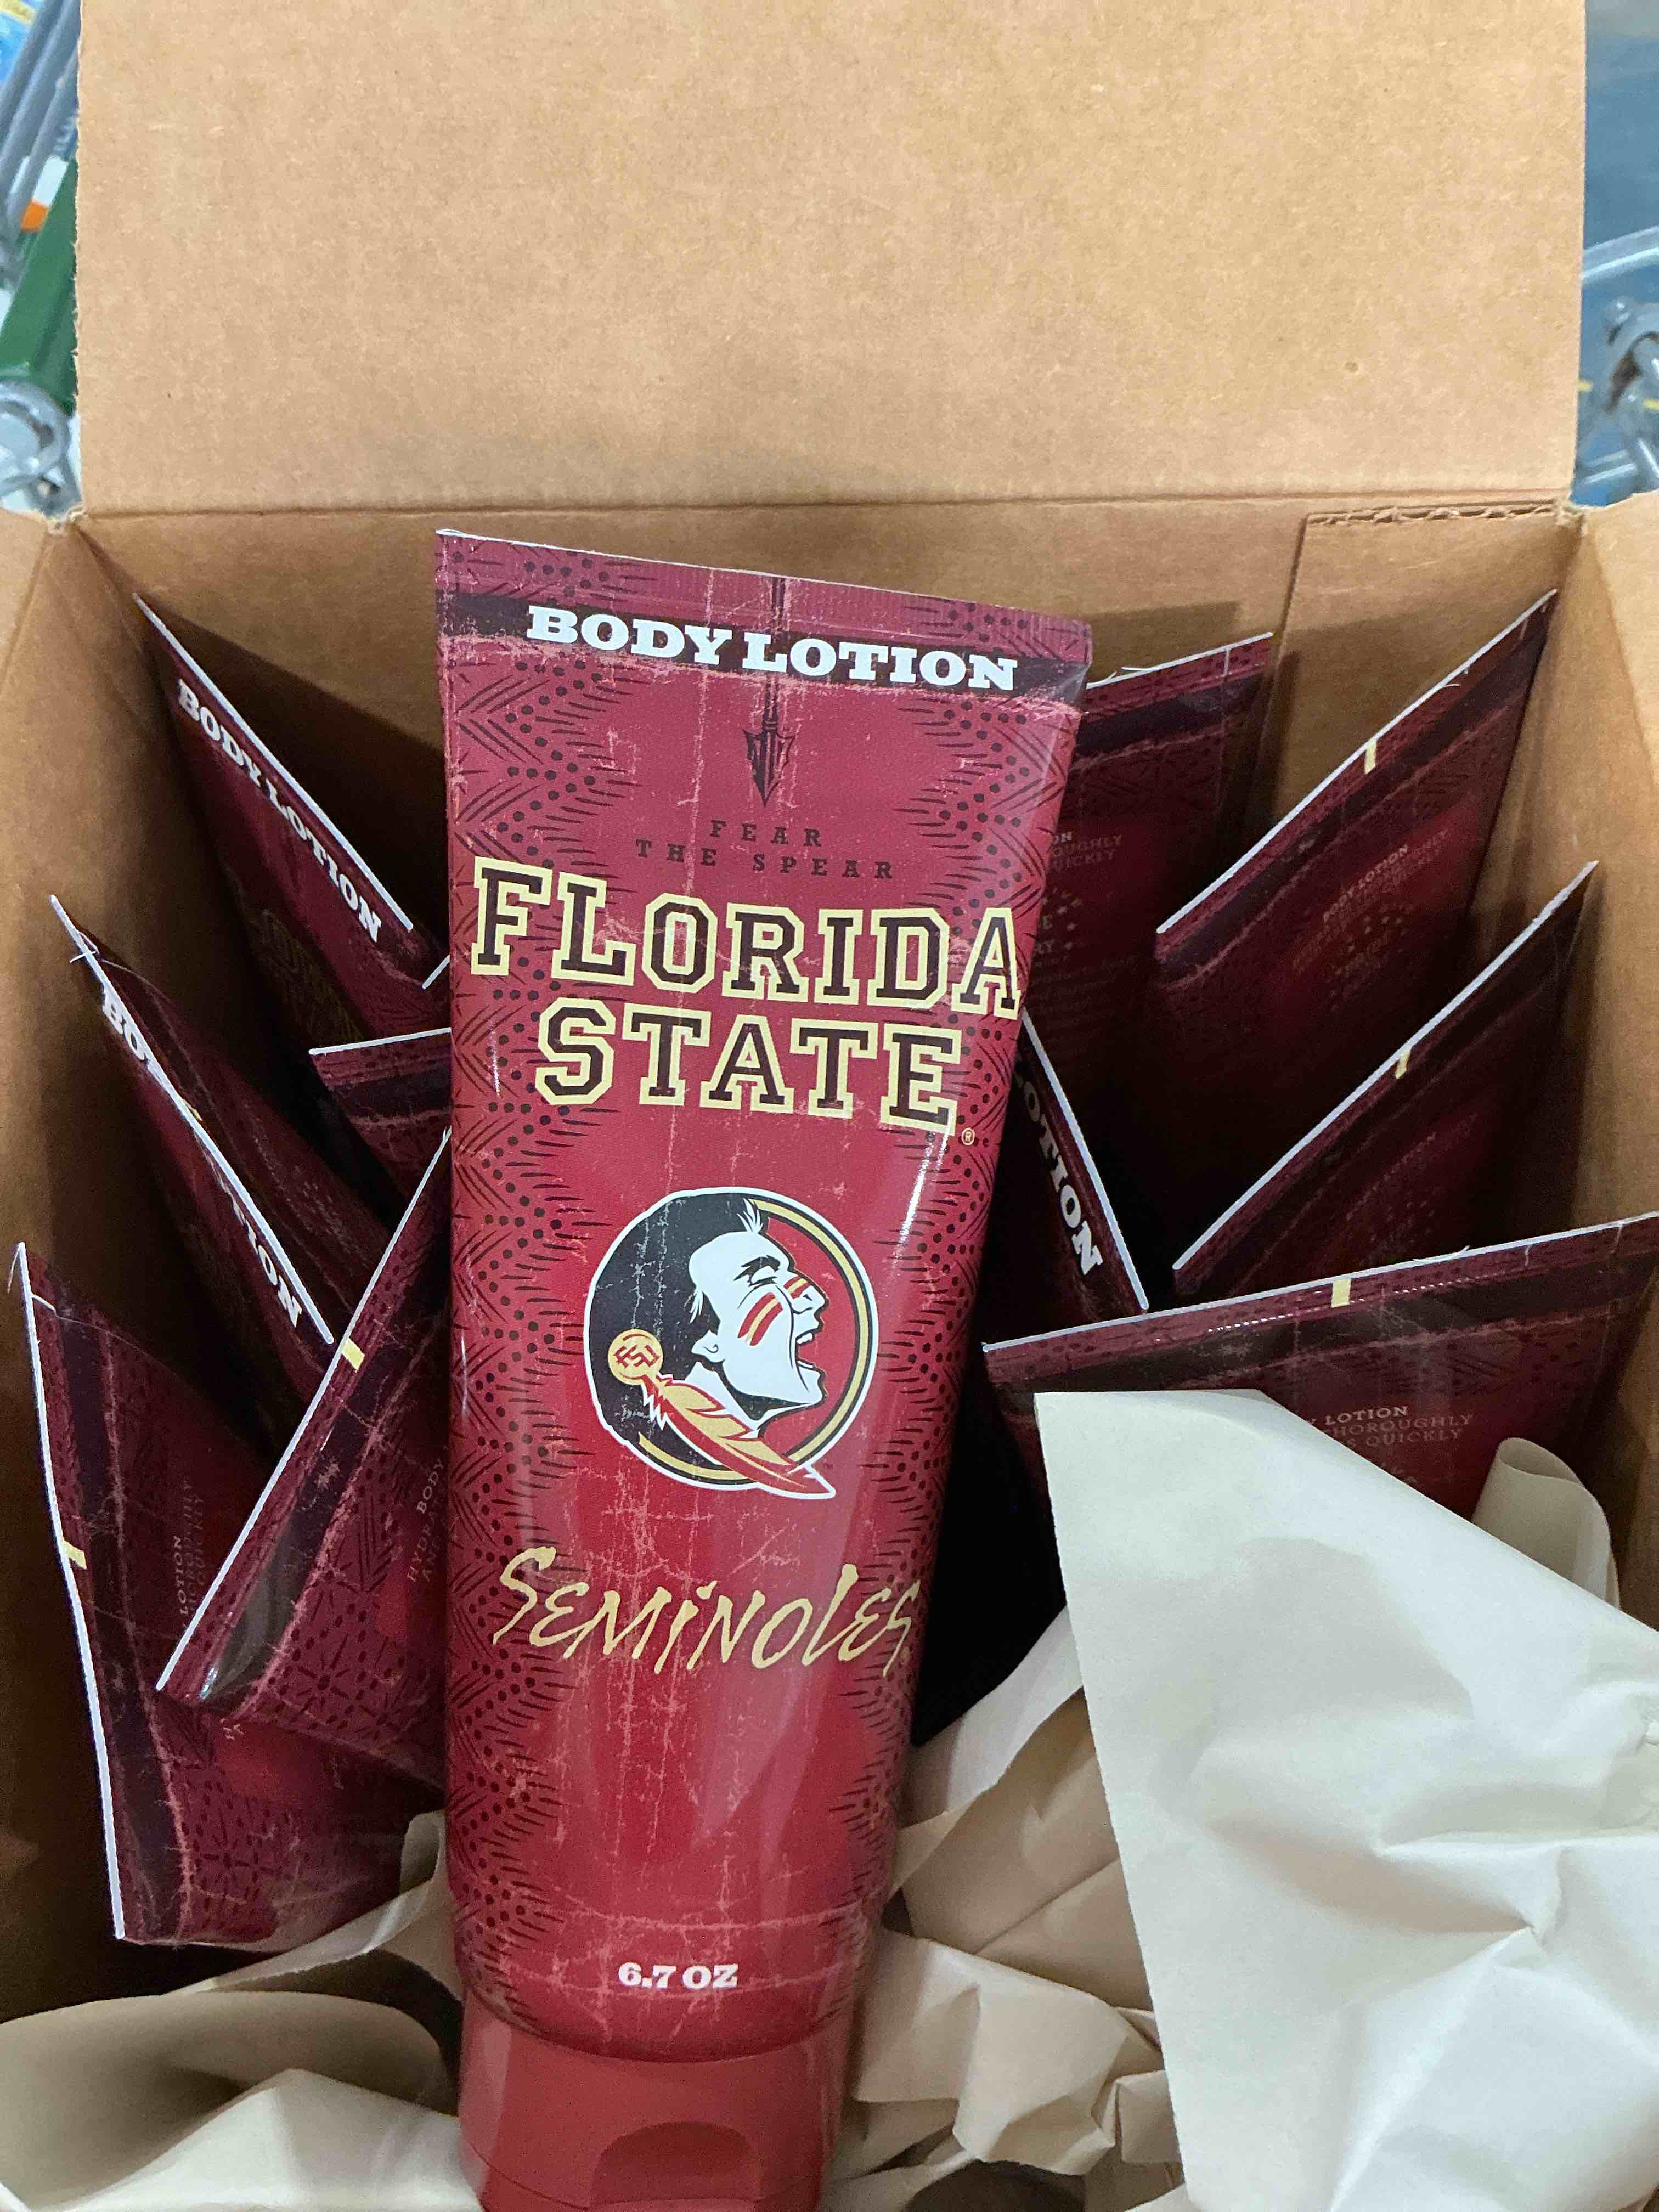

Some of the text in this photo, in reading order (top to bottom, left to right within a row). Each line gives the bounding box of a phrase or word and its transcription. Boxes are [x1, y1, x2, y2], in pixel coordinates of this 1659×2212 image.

[526, 605, 1018, 691] BODY LOTION
[177, 679, 382, 943] BODY LOTION
[710, 820, 822, 848] FEAR
[636, 839, 893, 879] THE SPEAR
[471, 856, 1022, 1020] FLORIDA
[534, 998, 962, 1136] STATE
[1325, 1406, 1409, 1426] LOTION
[1330, 1413, 1474, 1437] HOROUGHLY
[1365, 1429, 1463, 1447] QUICKLY
[416, 1457, 443, 1514] BODY
[174, 1536, 189, 1615] LOTION
[618, 1962, 738, 1990] 6.7 OZ
